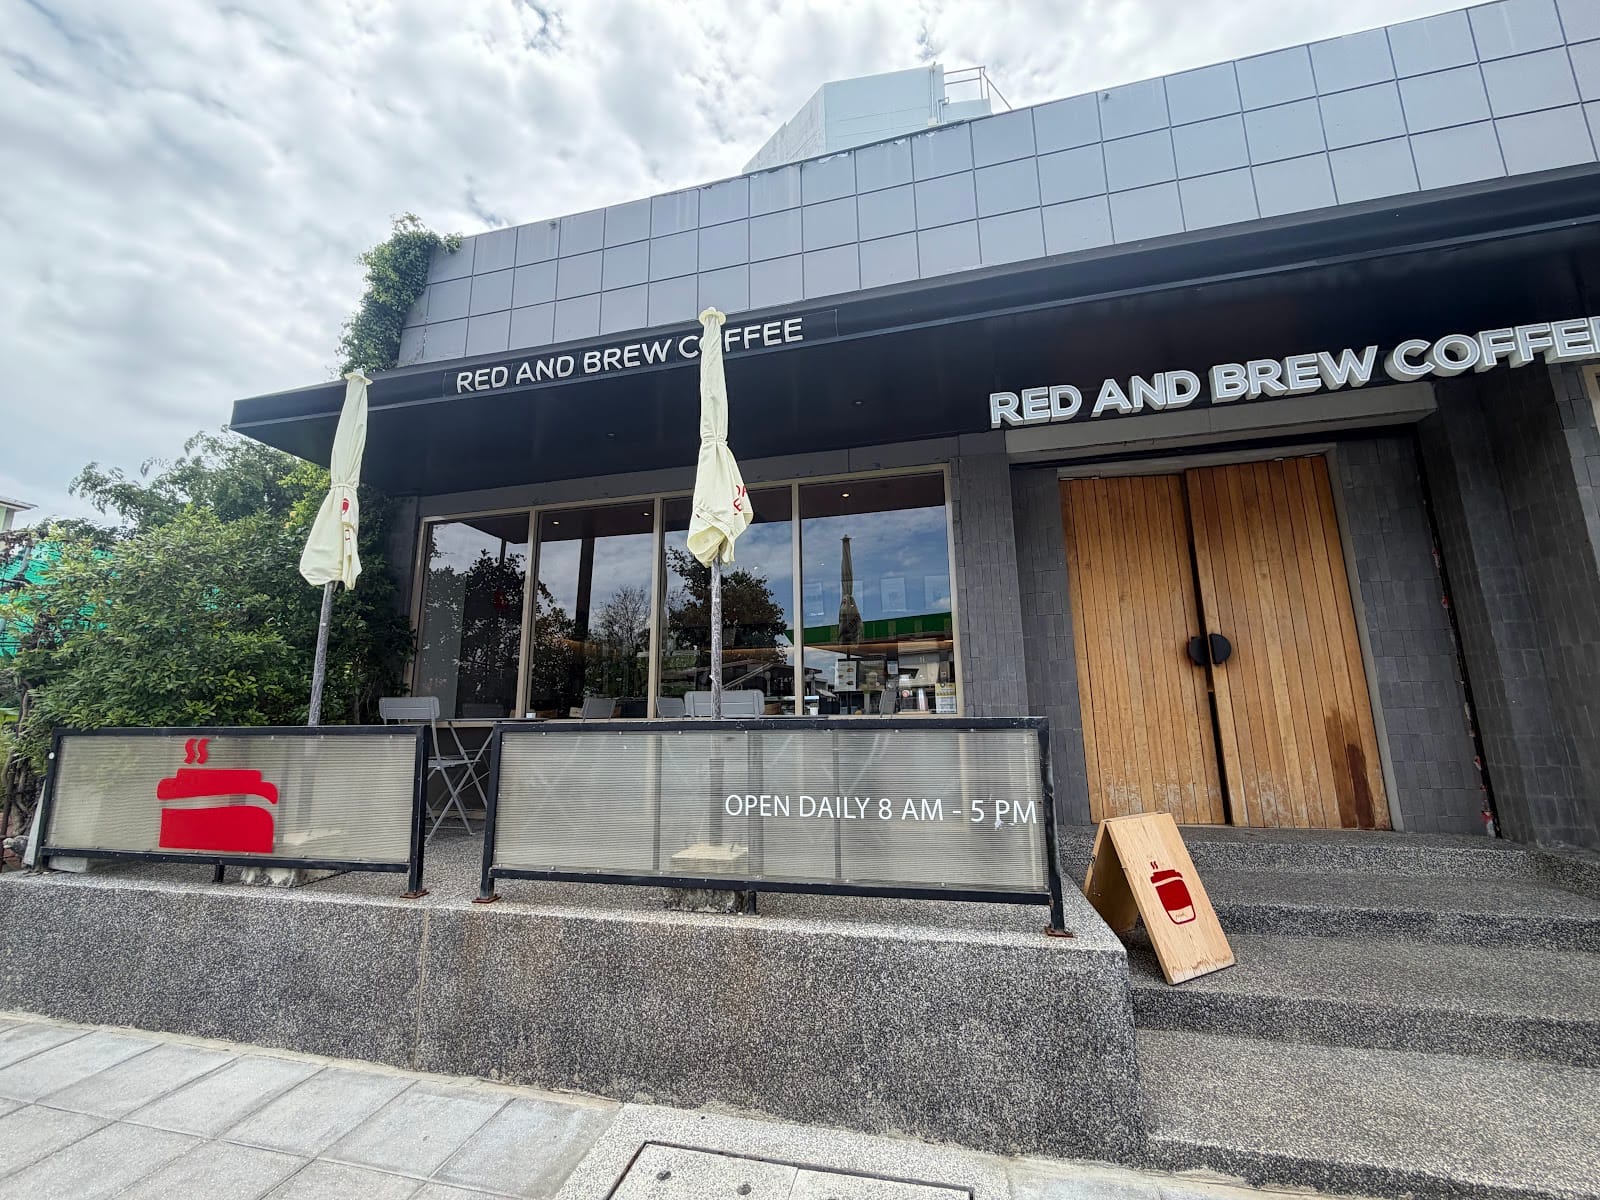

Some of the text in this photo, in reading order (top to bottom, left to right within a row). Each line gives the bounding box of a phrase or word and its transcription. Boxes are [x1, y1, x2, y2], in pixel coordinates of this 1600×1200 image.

[456, 317, 803, 393] RED AND BREW CFFEE
[990, 316, 1600, 428] RED AND BREW COFFE
[725, 794, 790, 817] OPEN
[799, 795, 870, 819] DAILY
[878, 798, 893, 820] 8
[901, 798, 944, 821] AM
[970, 800, 985, 822] 5
[995, 800, 1037, 824] PM
